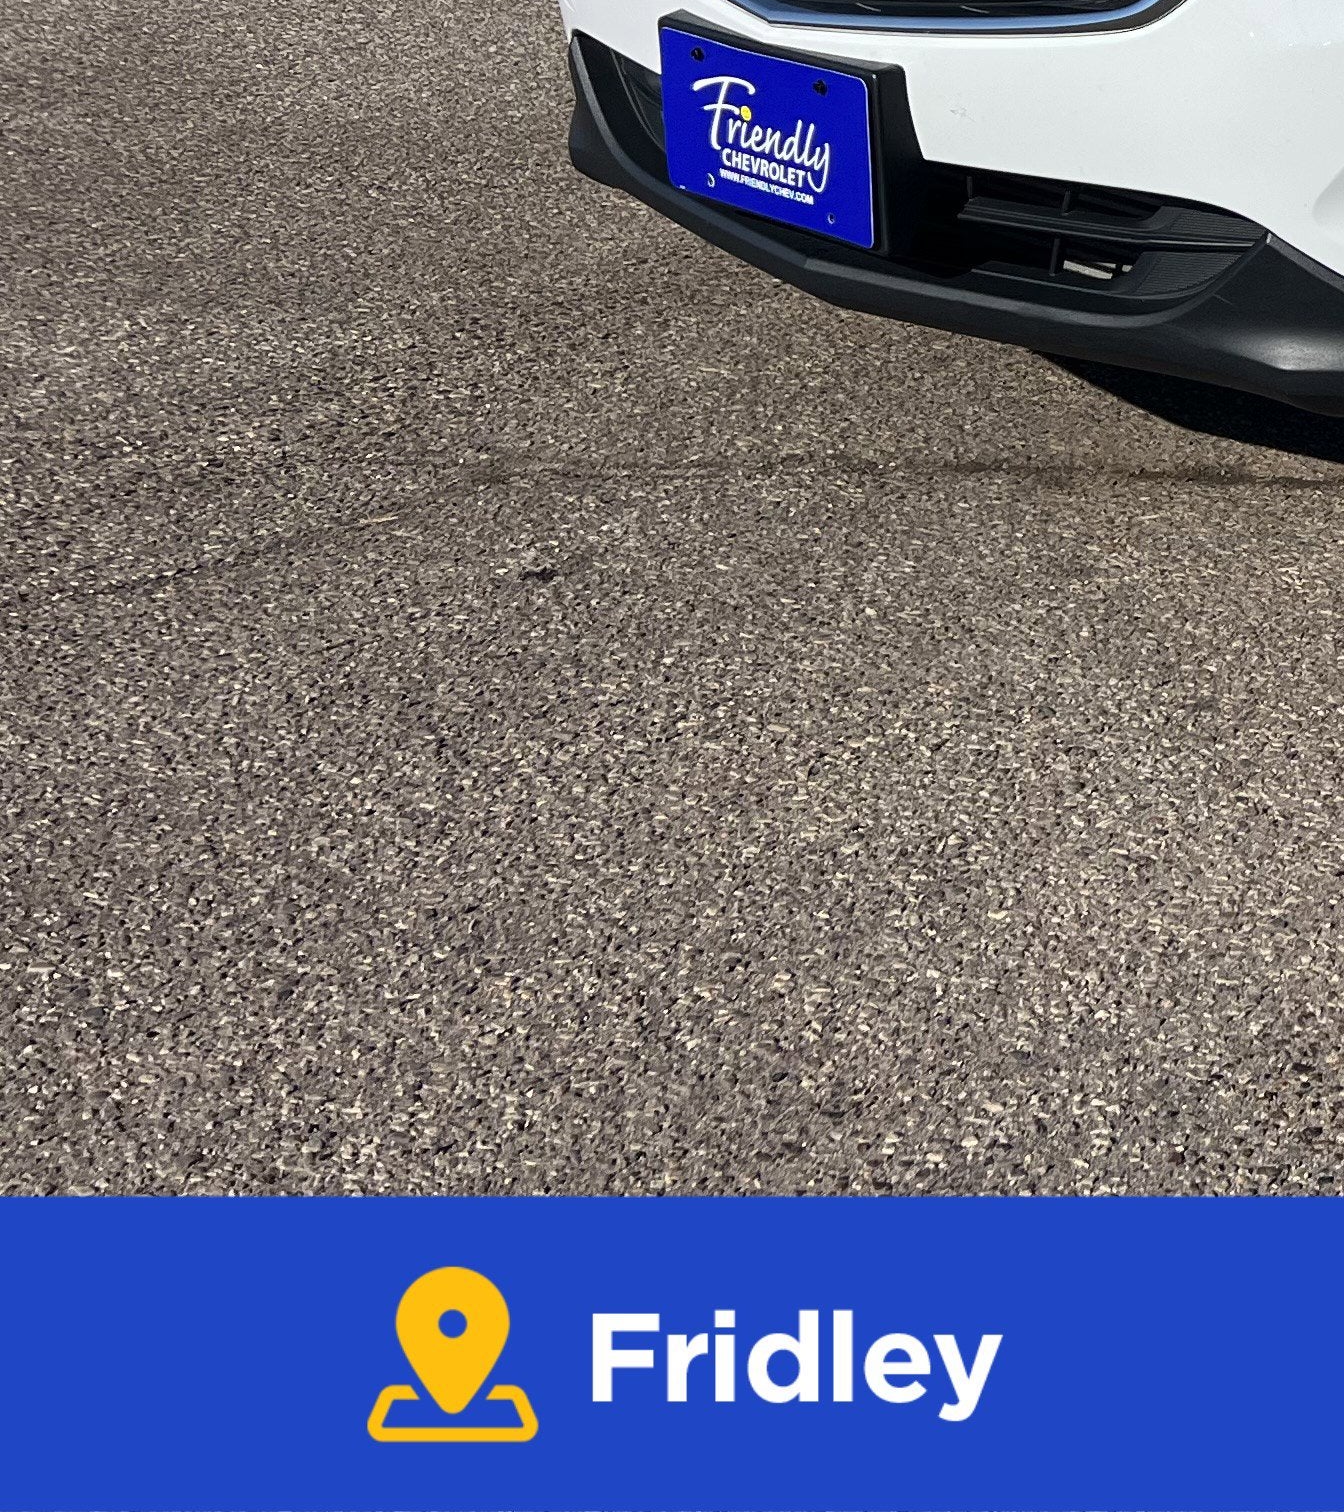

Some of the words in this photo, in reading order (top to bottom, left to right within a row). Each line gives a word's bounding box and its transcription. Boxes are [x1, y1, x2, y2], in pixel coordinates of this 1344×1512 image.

[691, 75, 830, 193] Friendly
[719, 167, 815, 206] WWW.FRIENDLYCHEV.COM
[721, 147, 807, 188] CHEVROLET
